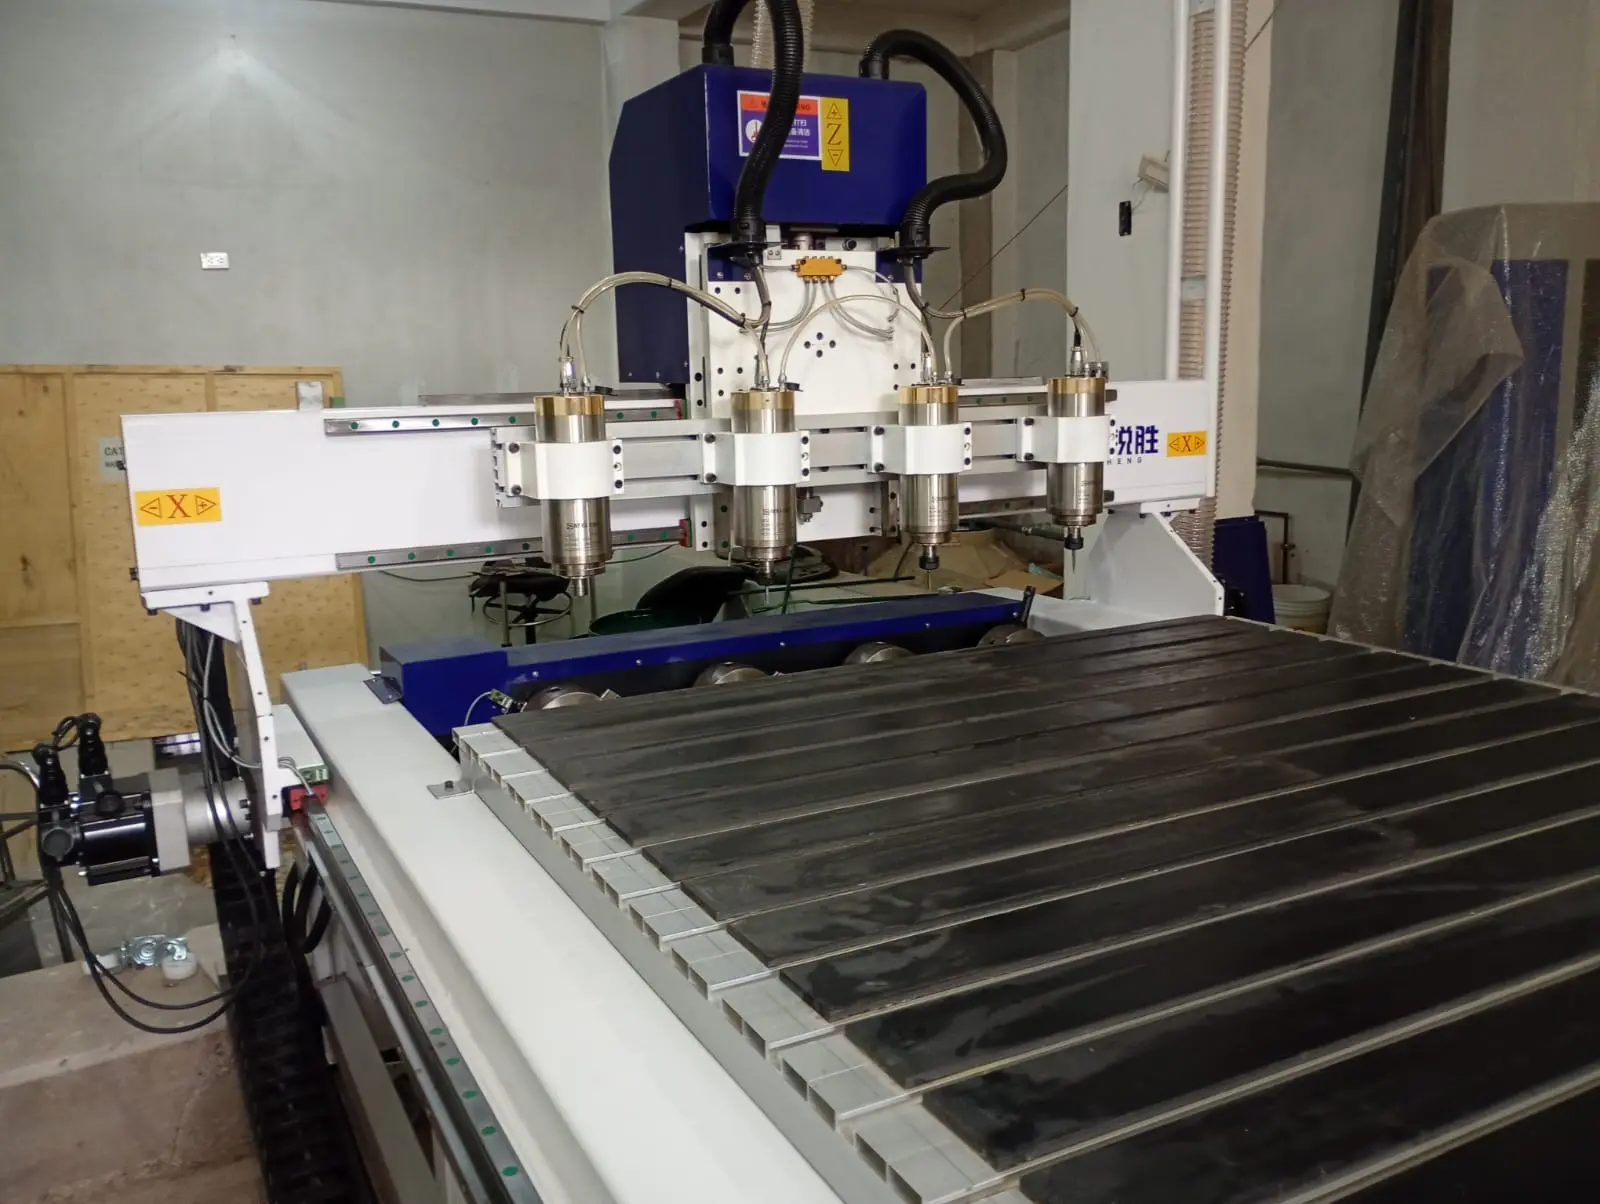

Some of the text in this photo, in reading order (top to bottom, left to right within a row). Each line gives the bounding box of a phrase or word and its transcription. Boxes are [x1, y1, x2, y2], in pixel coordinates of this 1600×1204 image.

[826, 122, 842, 146] Z
[1181, 435, 1192, 452] X
[165, 494, 193, 519] X
